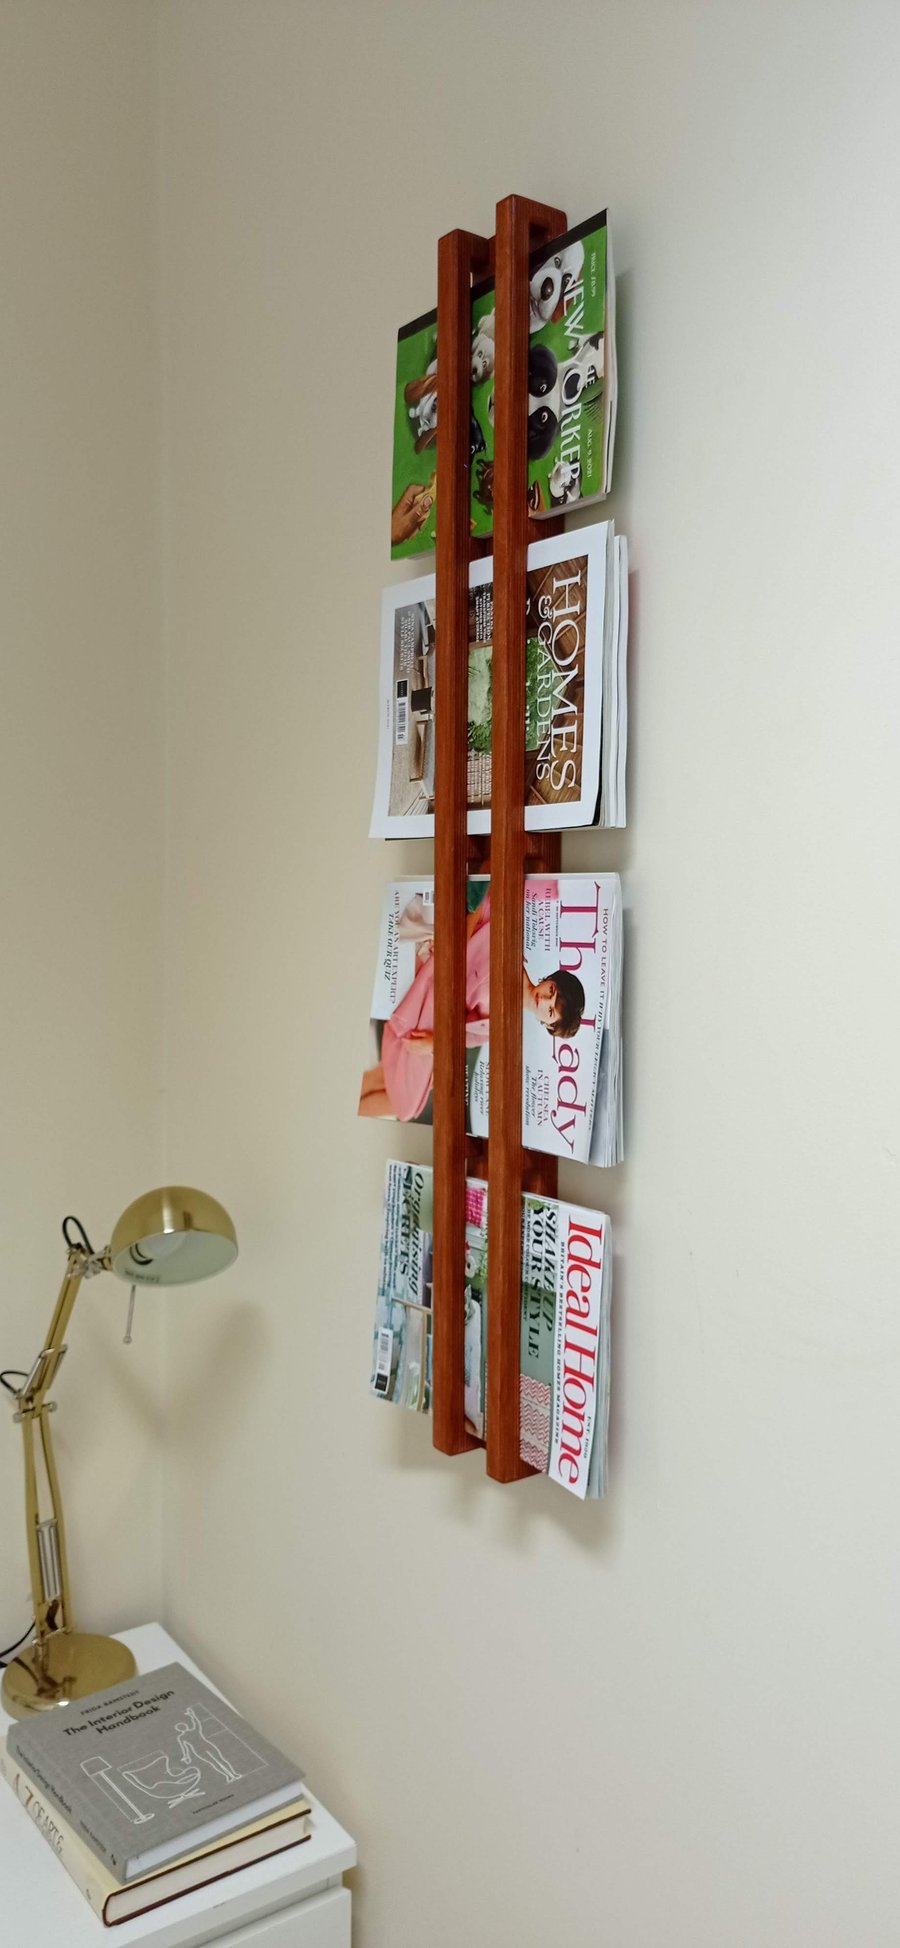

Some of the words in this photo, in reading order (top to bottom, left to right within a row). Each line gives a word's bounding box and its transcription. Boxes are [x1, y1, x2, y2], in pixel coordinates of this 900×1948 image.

[560, 367, 583, 479] ORKER
[537, 594, 553, 620] &
[536, 621, 553, 780] GARDENS
[550, 570, 582, 791] HOMES
[393, 930, 399, 943] AN
[559, 880, 601, 973] Th
[602, 940, 608, 953] TO
[383, 959, 392, 982] QUIZ
[599, 990, 605, 999] IT
[538, 1069, 544, 1081] IN
[400, 1180, 412, 1277] ECRETS
[407, 1173, 425, 1297] Organising
[531, 1207, 544, 1272] YOUR
[543, 1207, 557, 1294] SHAKE
[564, 1214, 603, 1337] Ideal
[528, 1277, 541, 1359] STYLE
[542, 1296, 554, 1332] UP
[558, 1334, 597, 1484] Home
[63, 1724, 88, 1736] The
[87, 1706, 133, 1727] Interior
[132, 1689, 176, 1710] Design
[96, 1705, 160, 1735] Handbook
